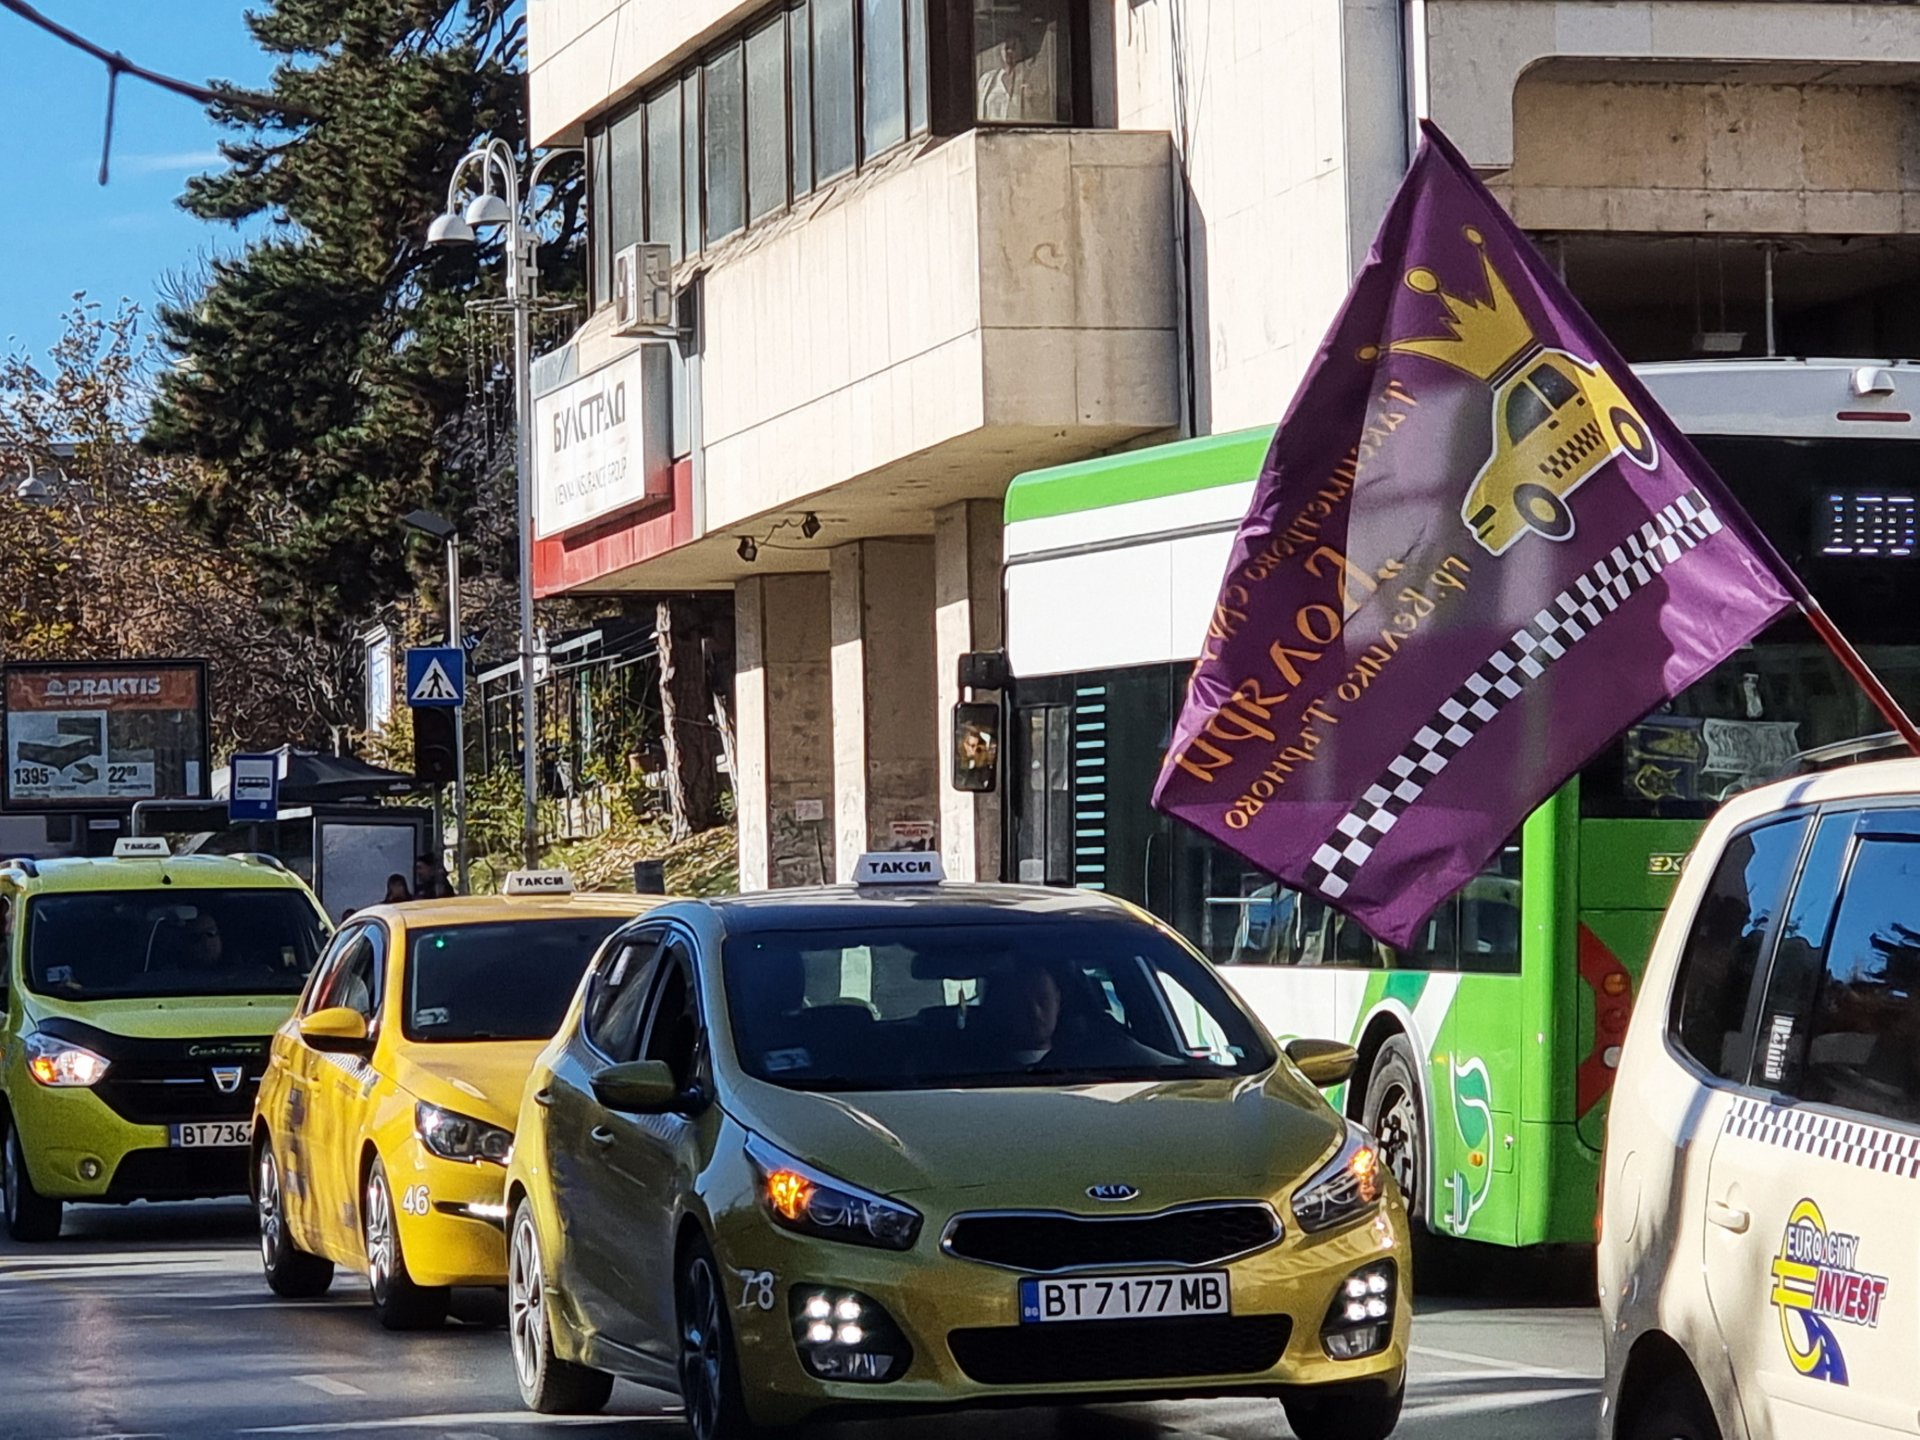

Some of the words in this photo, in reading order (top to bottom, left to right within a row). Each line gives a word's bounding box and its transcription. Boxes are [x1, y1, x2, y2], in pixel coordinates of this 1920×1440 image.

[552, 380, 626, 454] БУЛСТРАД
[67, 677, 161, 696] PRAKTIS
[515, 876, 565, 887] ТАКСИ
[869, 861, 932, 874] ТАКСИ
[402, 1184, 430, 1216] 46
[1094, 1185, 1132, 1197] KIA
[736, 1268, 776, 1311] 78
[1095, 1279, 1173, 1315] 7177
[1813, 1270, 1888, 1324] INVEST
